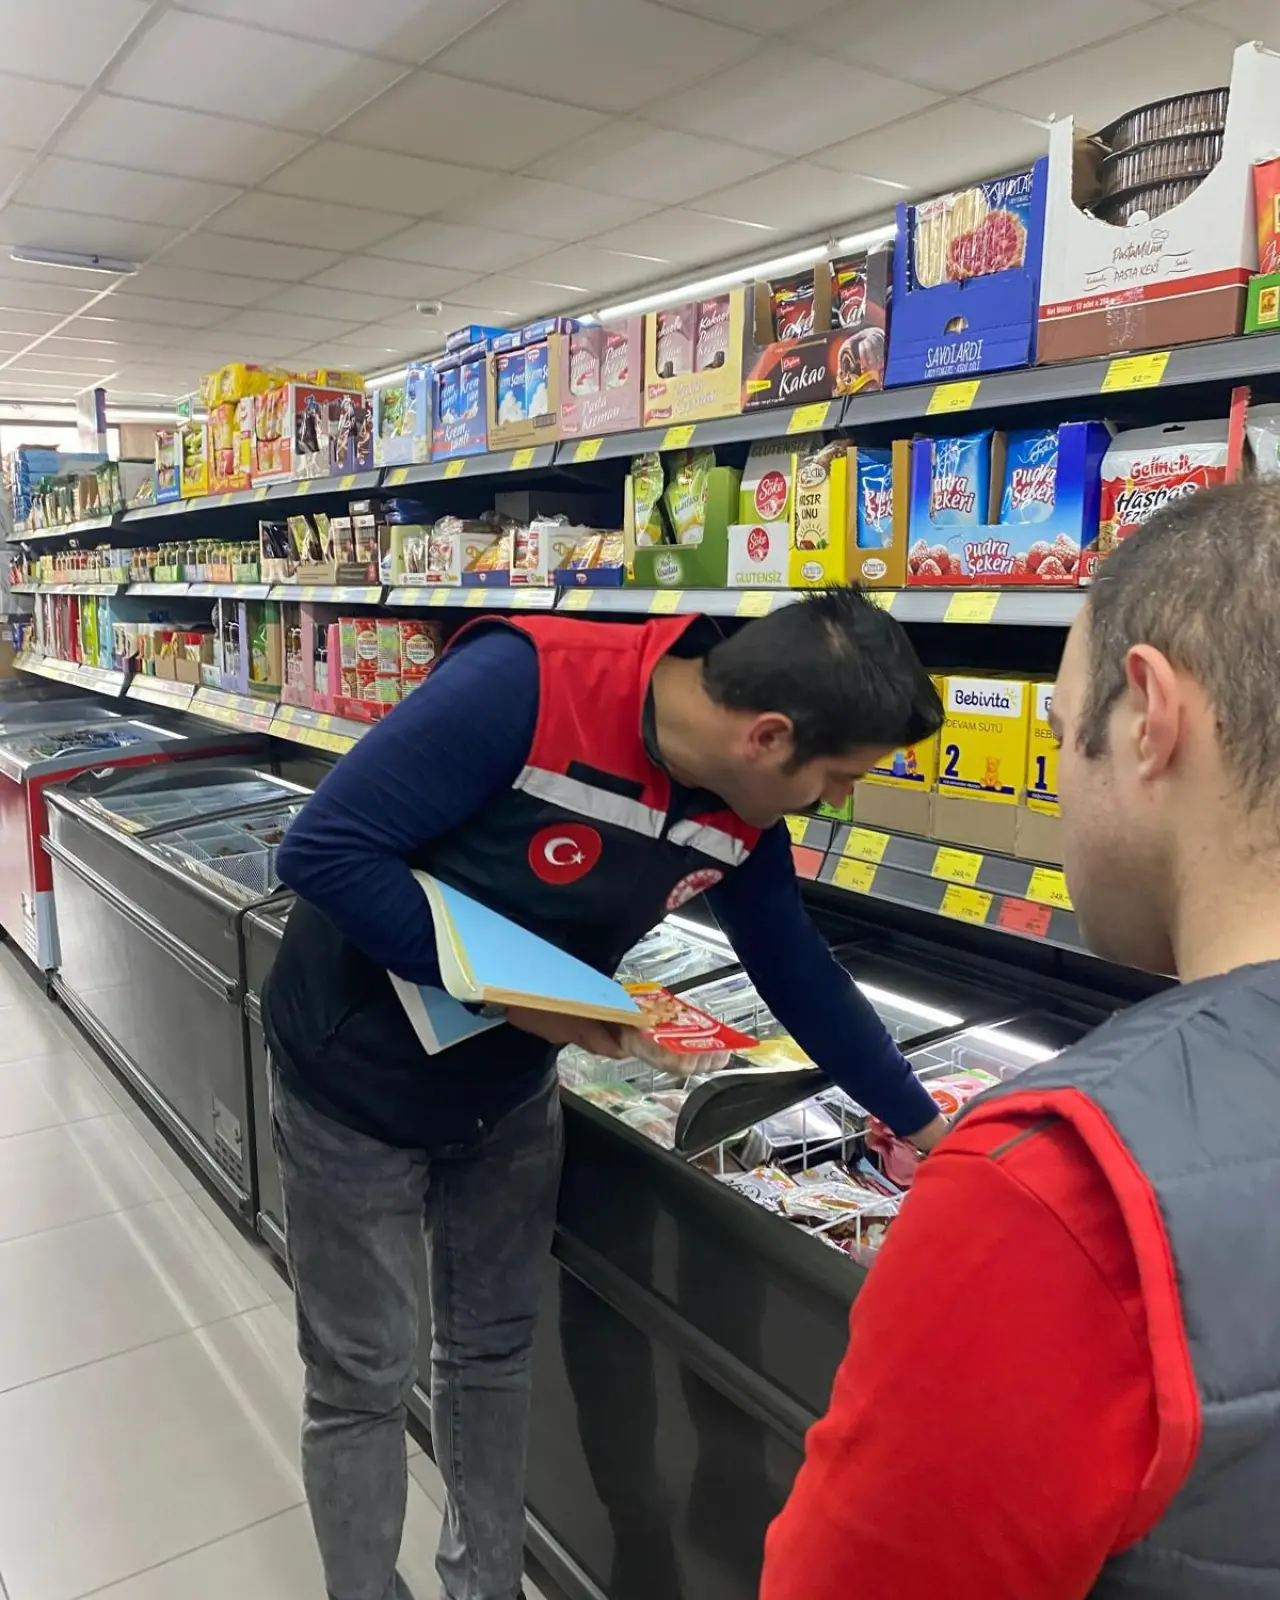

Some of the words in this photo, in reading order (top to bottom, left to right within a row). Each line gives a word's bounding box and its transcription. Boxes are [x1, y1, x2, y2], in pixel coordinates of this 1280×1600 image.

[1113, 269, 1138, 283] PASTA
[925, 339, 984, 369] SAVOIARDI
[778, 365, 826, 398] Kakao
[758, 477, 784, 502] Söke
[934, 491, 976, 513] ekeri
[963, 537, 1010, 562] Pudra
[735, 568, 782, 584] GLUTENSİZ
[966, 554, 1016, 579] Şekeri
[955, 689, 1010, 709] Bebivita
[945, 718, 977, 731] DEVAM
[944, 743, 960, 777] 2
[1034, 755, 1048, 790] 1
